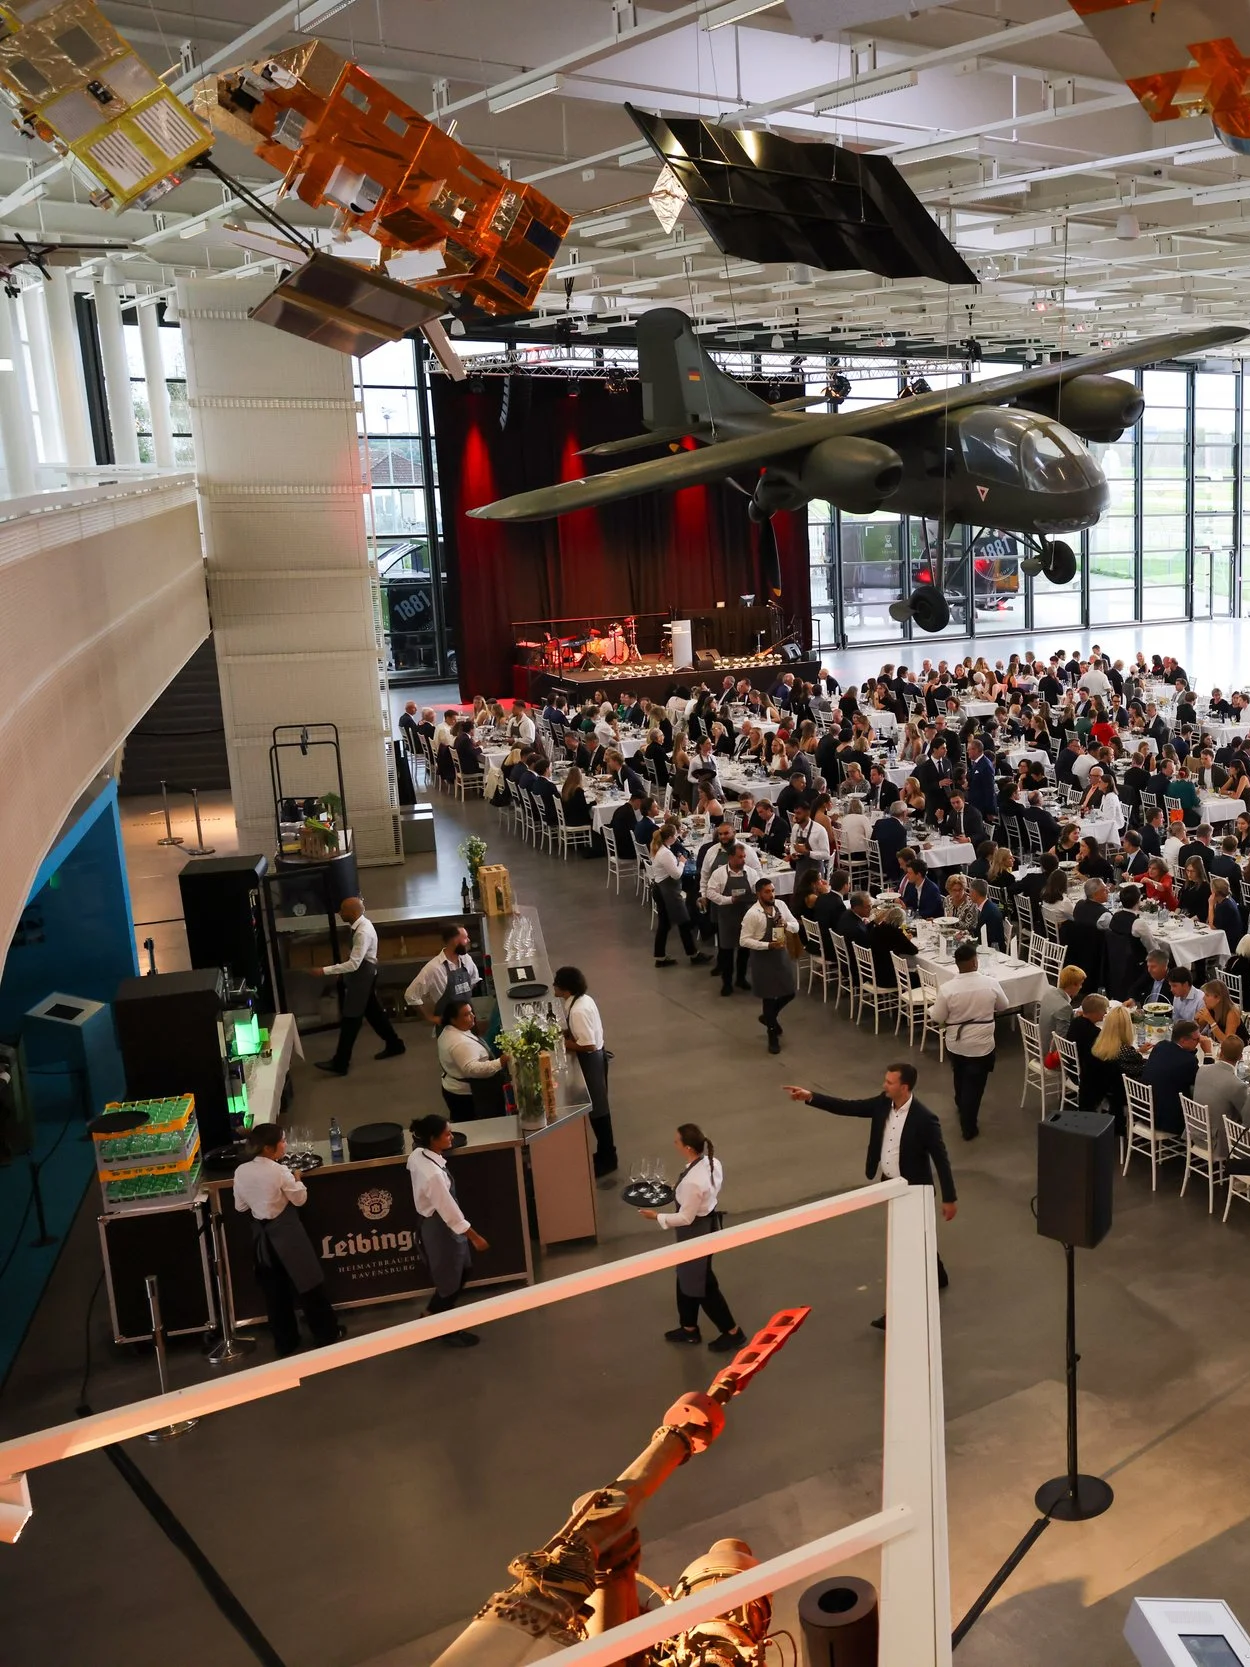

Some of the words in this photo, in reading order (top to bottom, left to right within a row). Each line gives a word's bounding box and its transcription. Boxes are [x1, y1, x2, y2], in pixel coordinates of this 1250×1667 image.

[980, 535, 1011, 563] 1881
[394, 590, 431, 621] 1881
[320, 1229, 421, 1259] Leibing
[351, 1265, 415, 1280] RAVENSBURG
